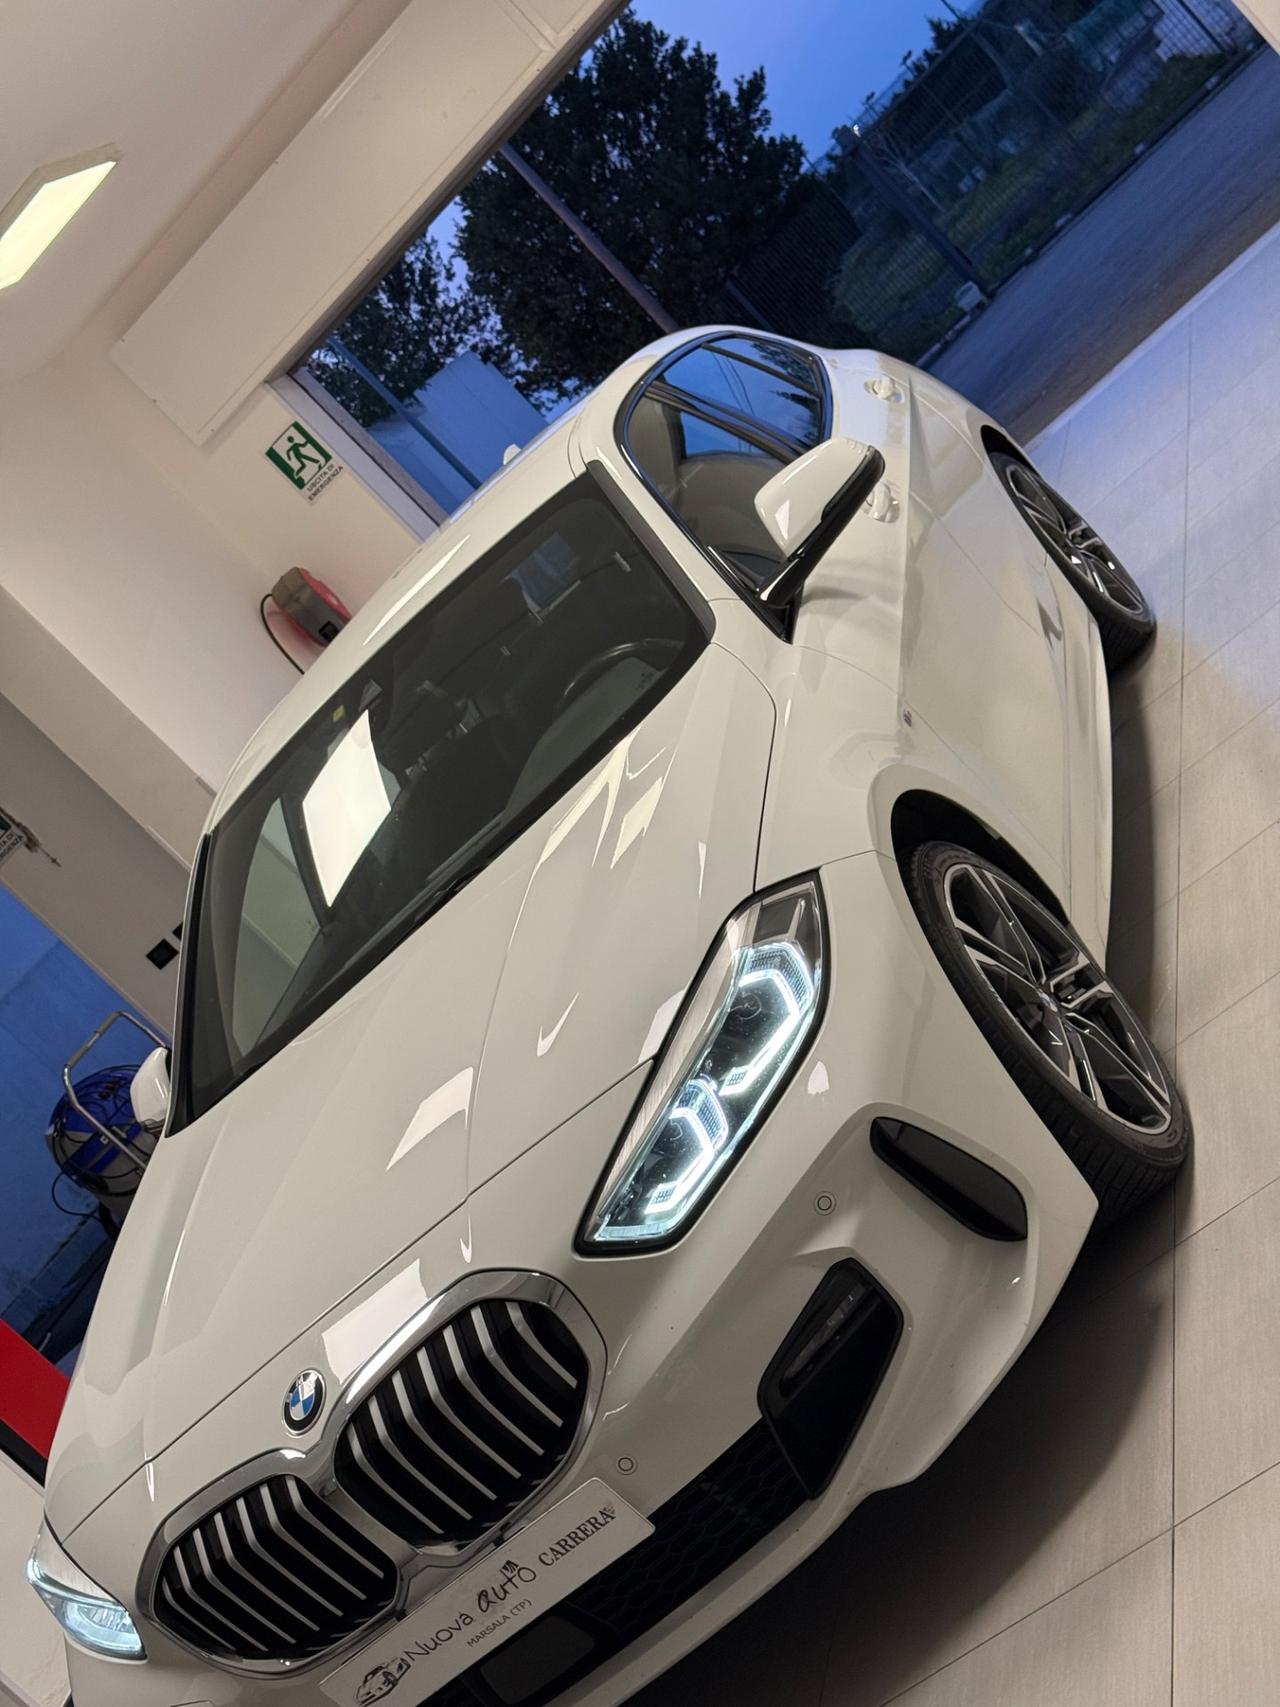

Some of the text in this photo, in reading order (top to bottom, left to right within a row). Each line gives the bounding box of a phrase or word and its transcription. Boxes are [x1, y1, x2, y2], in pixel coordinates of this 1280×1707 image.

[306, 471, 330, 492] USCITA
[308, 465, 344, 501] EMERGENZA
[403, 1610, 474, 1662] Nuova
[538, 1510, 617, 1567] CARRERA
[466, 1598, 532, 1647] MARSALA (TP)
